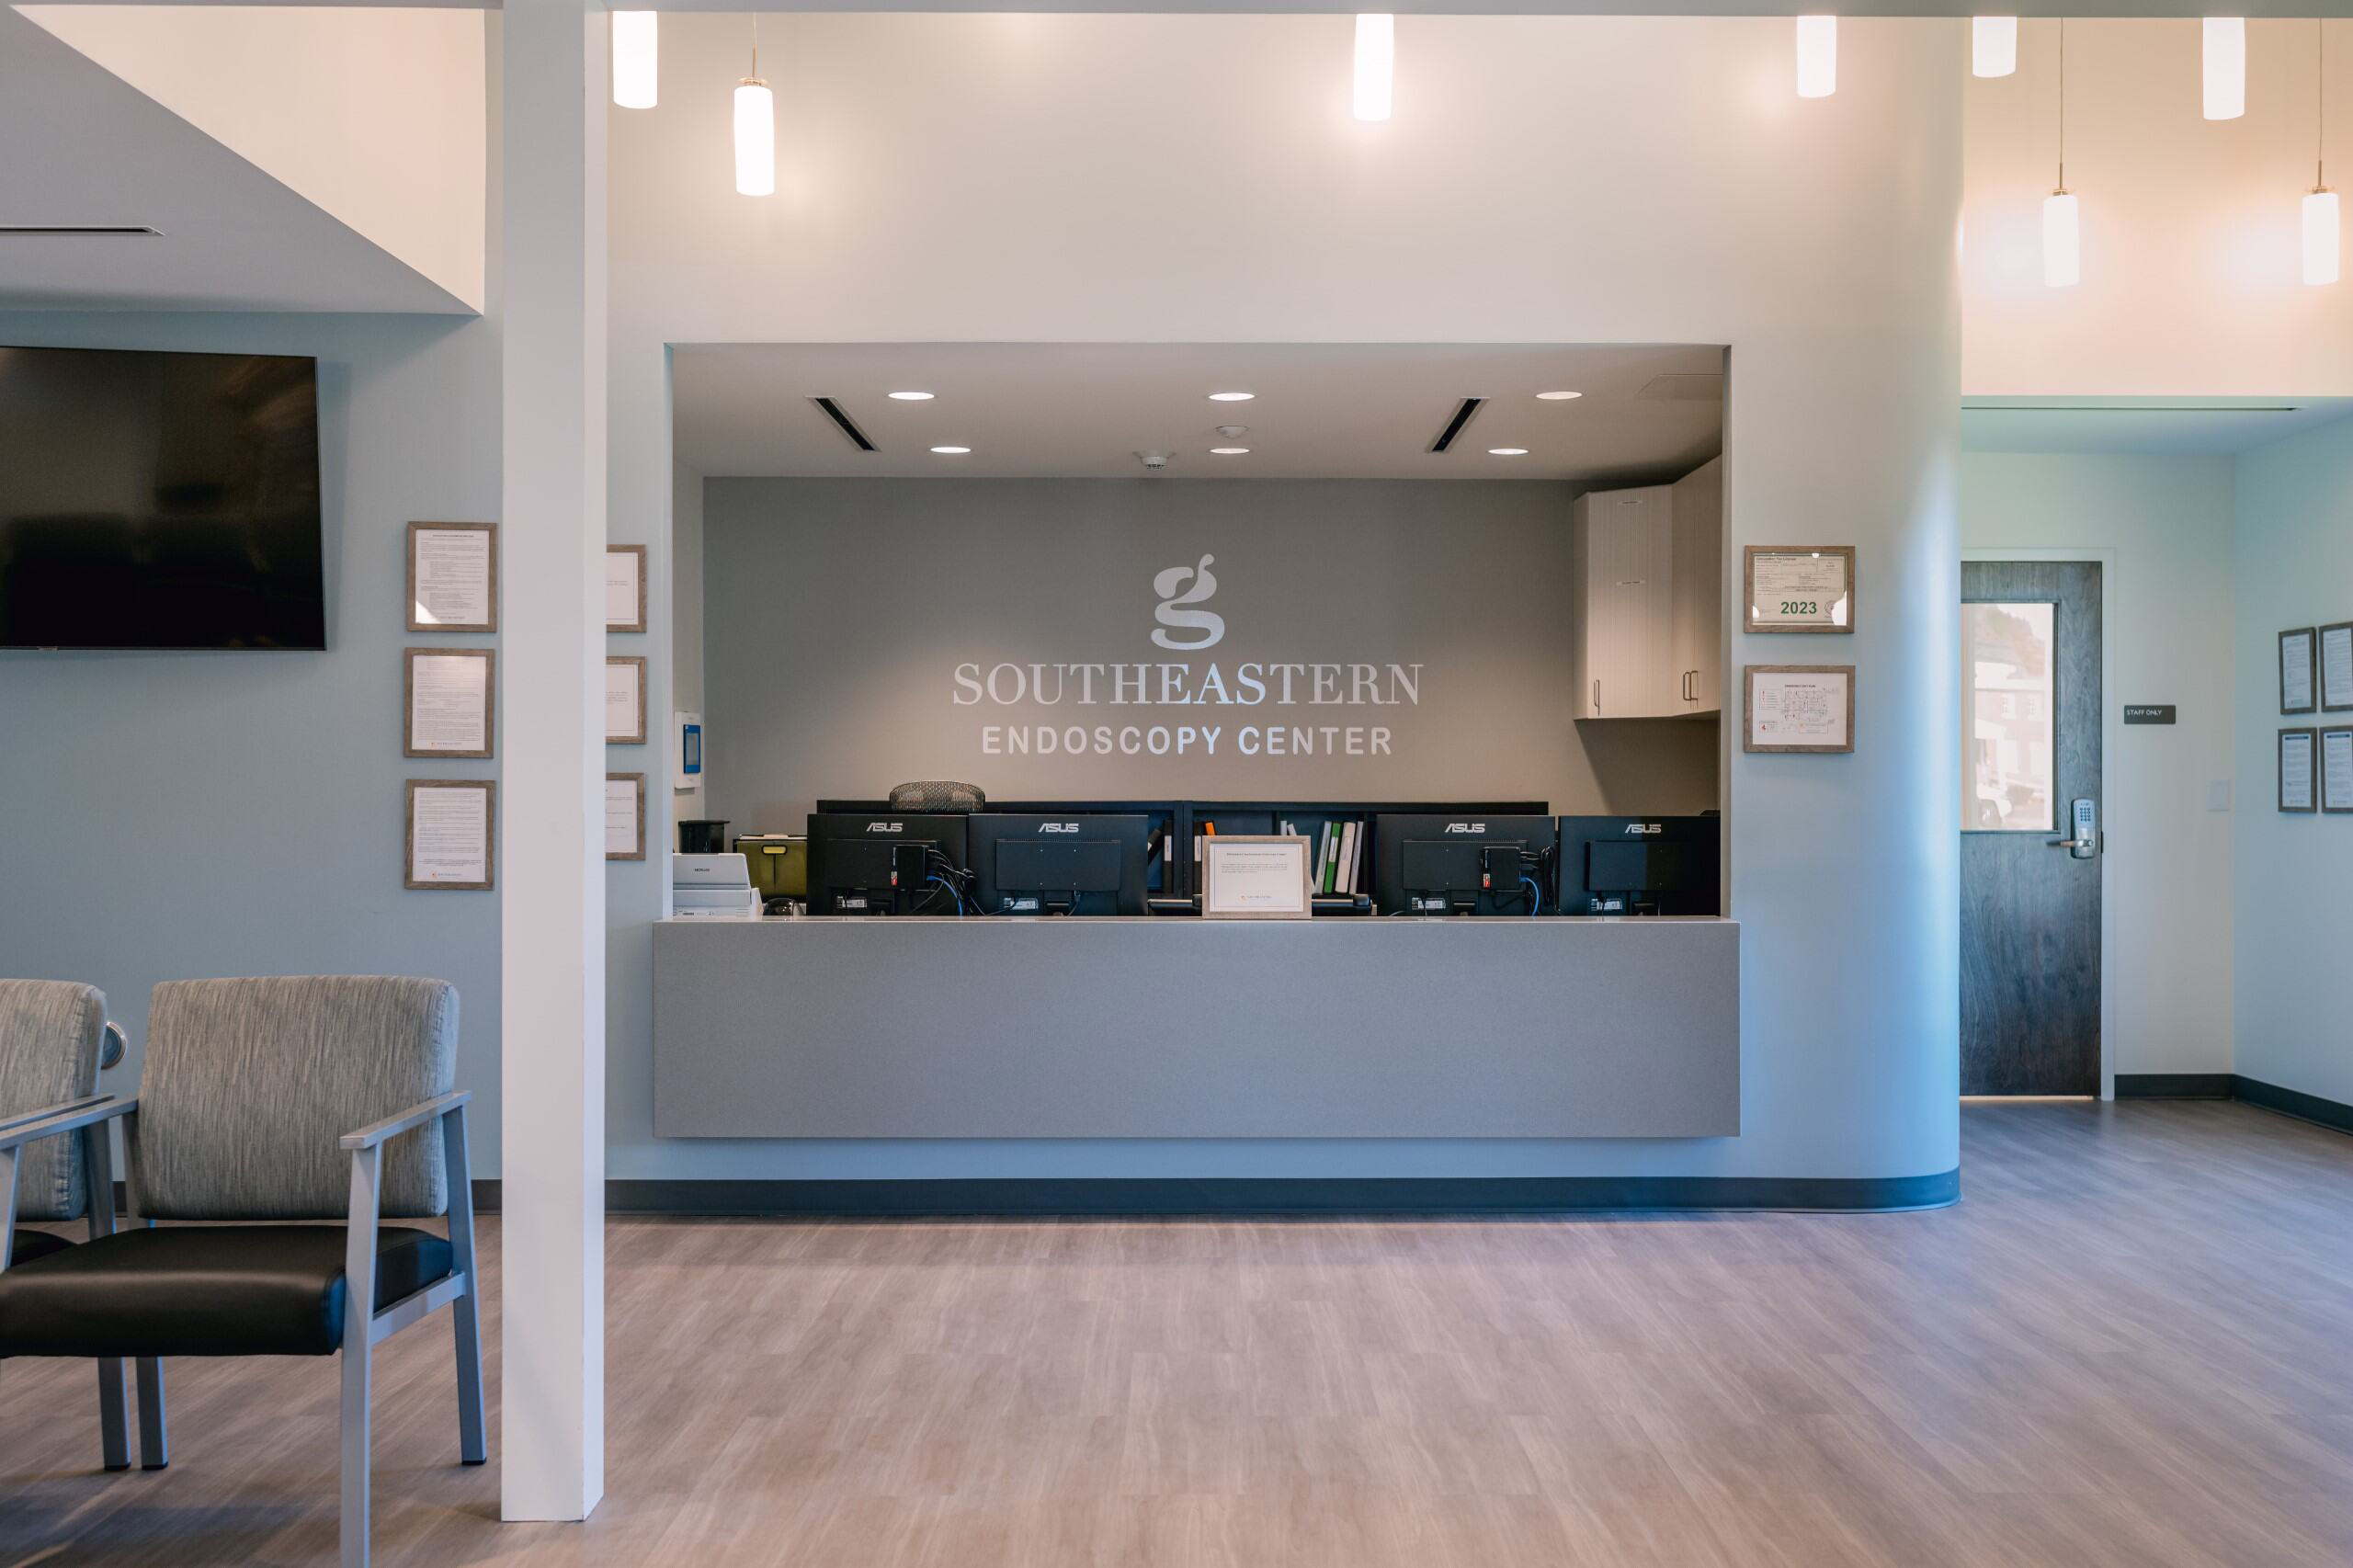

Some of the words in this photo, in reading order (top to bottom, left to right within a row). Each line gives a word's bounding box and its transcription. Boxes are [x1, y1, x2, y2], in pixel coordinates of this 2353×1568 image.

[1780, 601, 1817, 615] 2023
[952, 663, 1424, 705] SOUTHEASTERN
[983, 725, 1222, 755] ENDOSCOPY
[1238, 726, 1392, 756] CENTER
[866, 822, 904, 833] ASUS
[1038, 823, 1080, 834] ASUS
[1444, 823, 1486, 834] ASUS
[1624, 824, 1662, 834] ASUS
